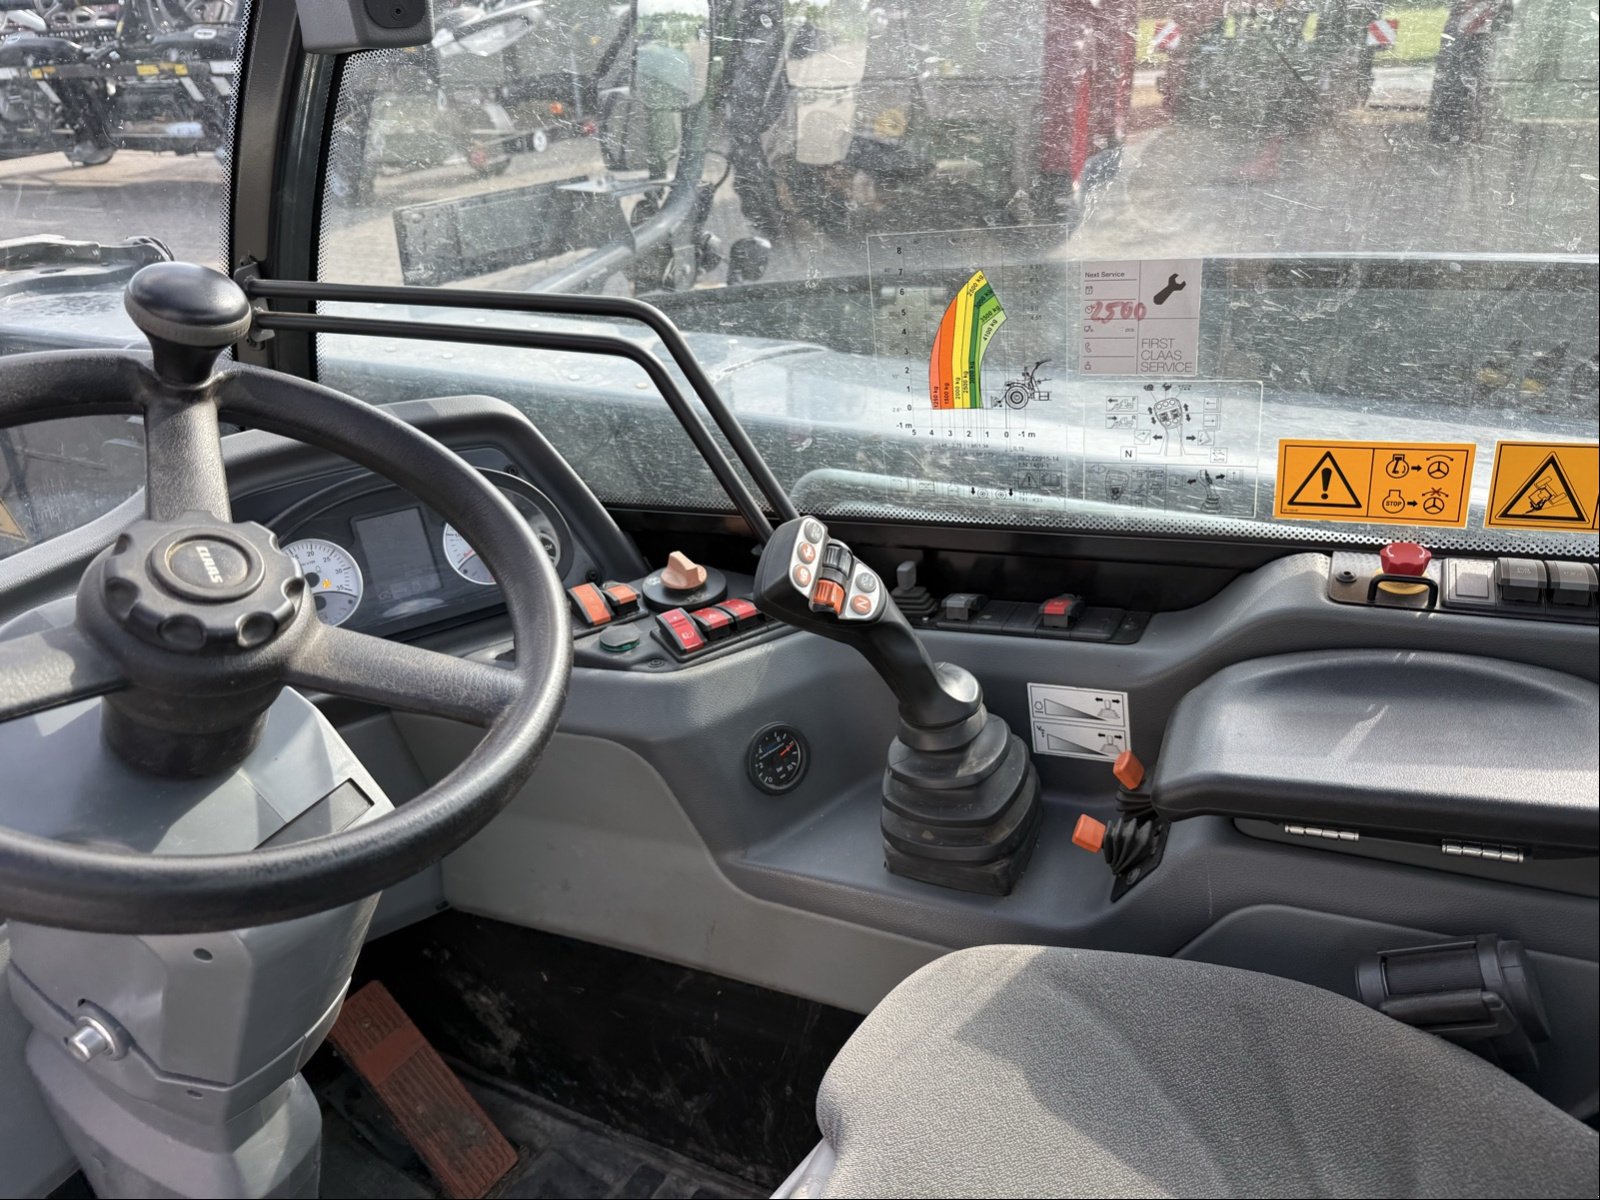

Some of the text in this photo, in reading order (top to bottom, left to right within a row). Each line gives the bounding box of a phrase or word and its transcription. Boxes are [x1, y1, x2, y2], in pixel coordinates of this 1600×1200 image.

[896, 247, 902, 255] 8
[898, 268, 903, 276] 7
[899, 288, 905, 296] 6
[901, 308, 907, 316] 5
[1090, 301, 1148, 324] 2500
[1141, 338, 1176, 349] FIRST
[904, 347, 909, 355] 3
[1141, 350, 1182, 361] CLAAS
[905, 366, 910, 374] 2
[1140, 361, 1193, 373] SERVICE
[966, 430, 972, 438] 2
[1125, 450, 1132, 458] N
[197, 546, 223, 583] CLAAS
